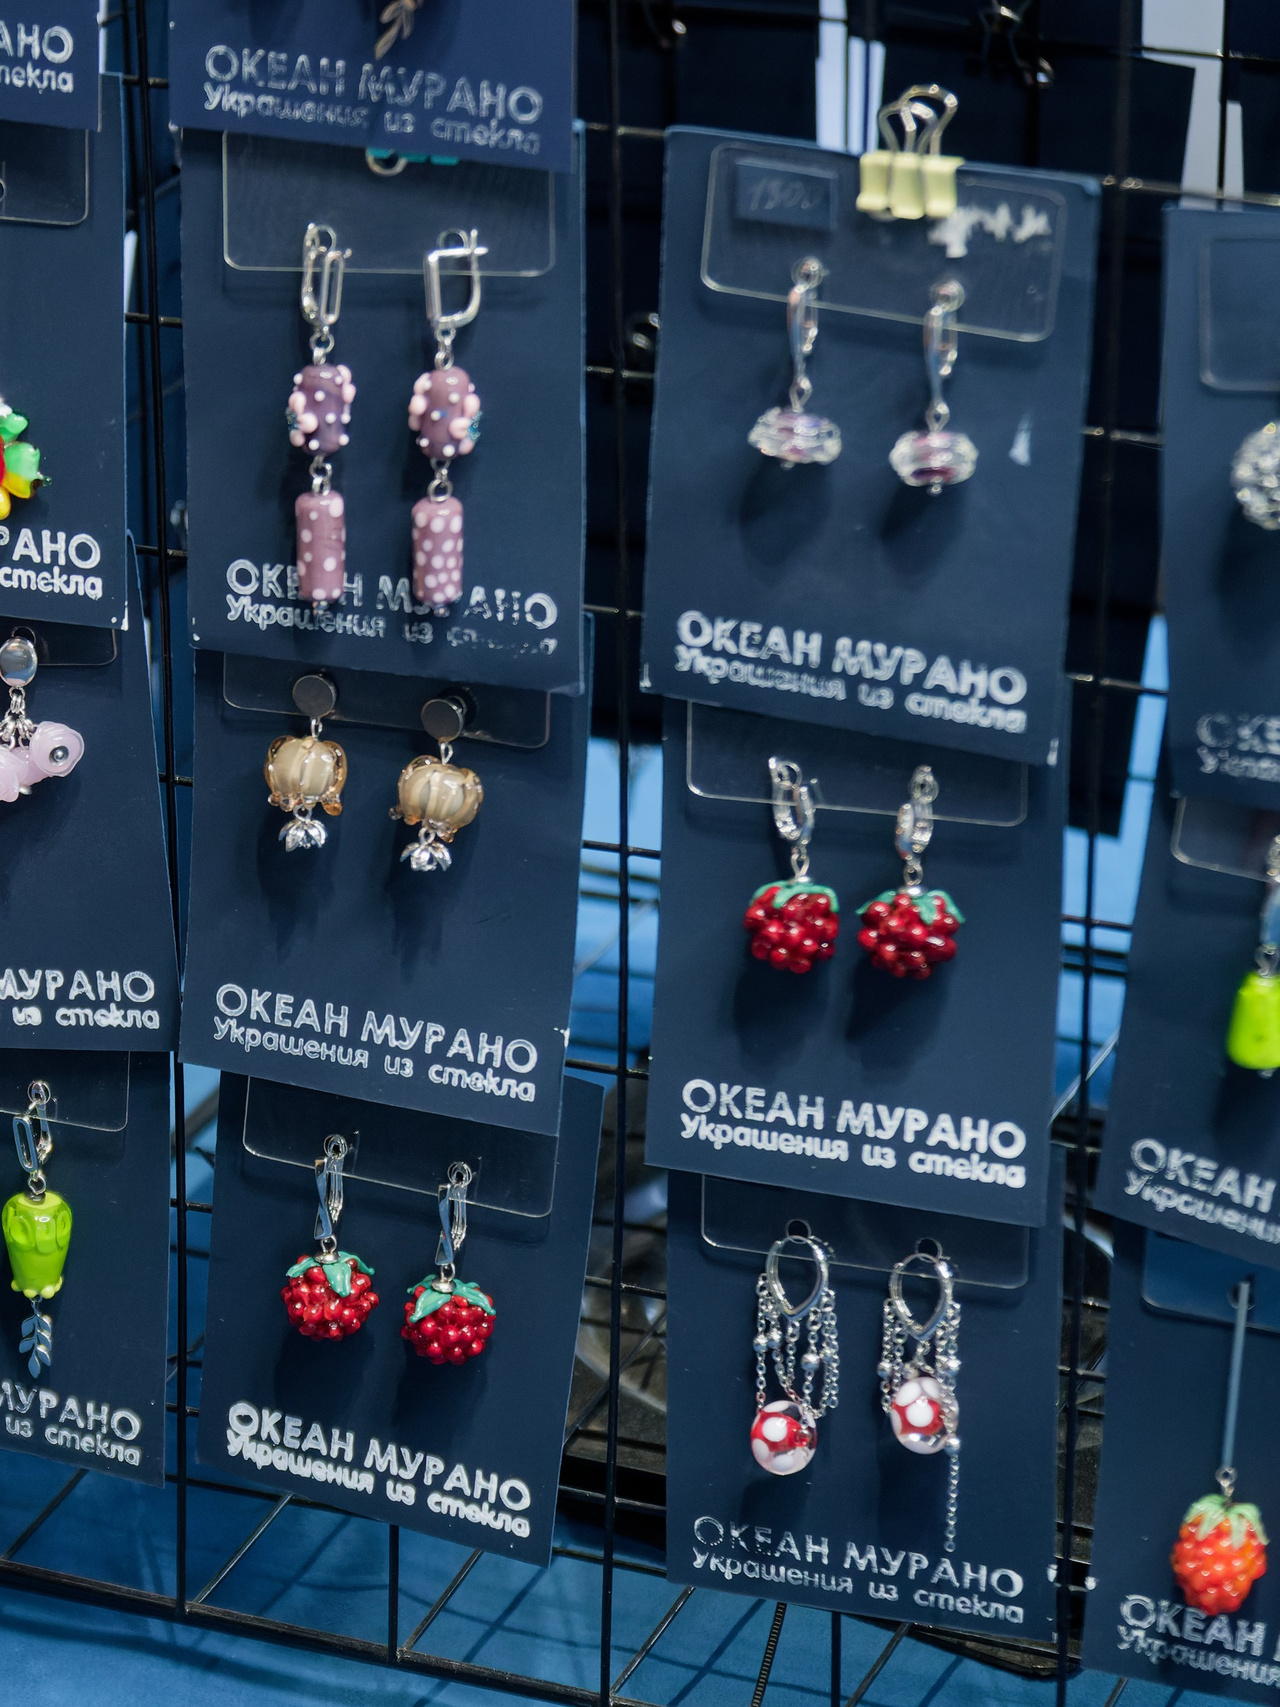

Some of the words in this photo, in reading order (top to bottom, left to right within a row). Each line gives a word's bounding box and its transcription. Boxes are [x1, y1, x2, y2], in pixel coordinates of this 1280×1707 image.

[205, 44, 346, 97] ОКЕАН
[358, 62, 544, 124] МУРАНО
[384, 110, 414, 134] из
[375, 575, 558, 630] МАНО
[675, 644, 847, 701] Украшения
[858, 682, 894, 710] из
[676, 609, 823, 669] ОКЕАН
[831, 636, 1028, 705] МУРАНО
[12, 1006, 42, 1026] из
[56, 1003, 160, 1030] стекла
[216, 983, 349, 1037] ОКЕАН
[361, 1010, 538, 1074] МУРАНО
[213, 1016, 369, 1068] Украшения
[384, 1055, 414, 1077] из
[428, 1064, 536, 1102] стекла
[680, 1112, 849, 1162] Украшения
[861, 1144, 897, 1168] из
[908, 1150, 1026, 1189] стекла
[682, 1078, 824, 1130] ОКЕАН
[836, 1100, 1027, 1159] МУРАНО
[1130, 1138, 1277, 1214] ОКЕАН
[5, 1416, 33, 1438] из
[44, 1424, 141, 1466] стекла
[228, 1402, 354, 1462] ОКЕАН
[364, 1438, 531, 1511] МУРАНО
[226, 1429, 374, 1494] Украшения
[386, 1479, 416, 1505] из
[427, 1492, 531, 1538] стекла
[692, 1546, 853, 1595] Украшения
[868, 1581, 899, 1601] из
[913, 1588, 1024, 1624] стекла
[694, 1516, 829, 1565] ОКЕАН
[843, 1541, 1024, 1598] МУРАНО
[1120, 1594, 1267, 1657] ОКЕАН
